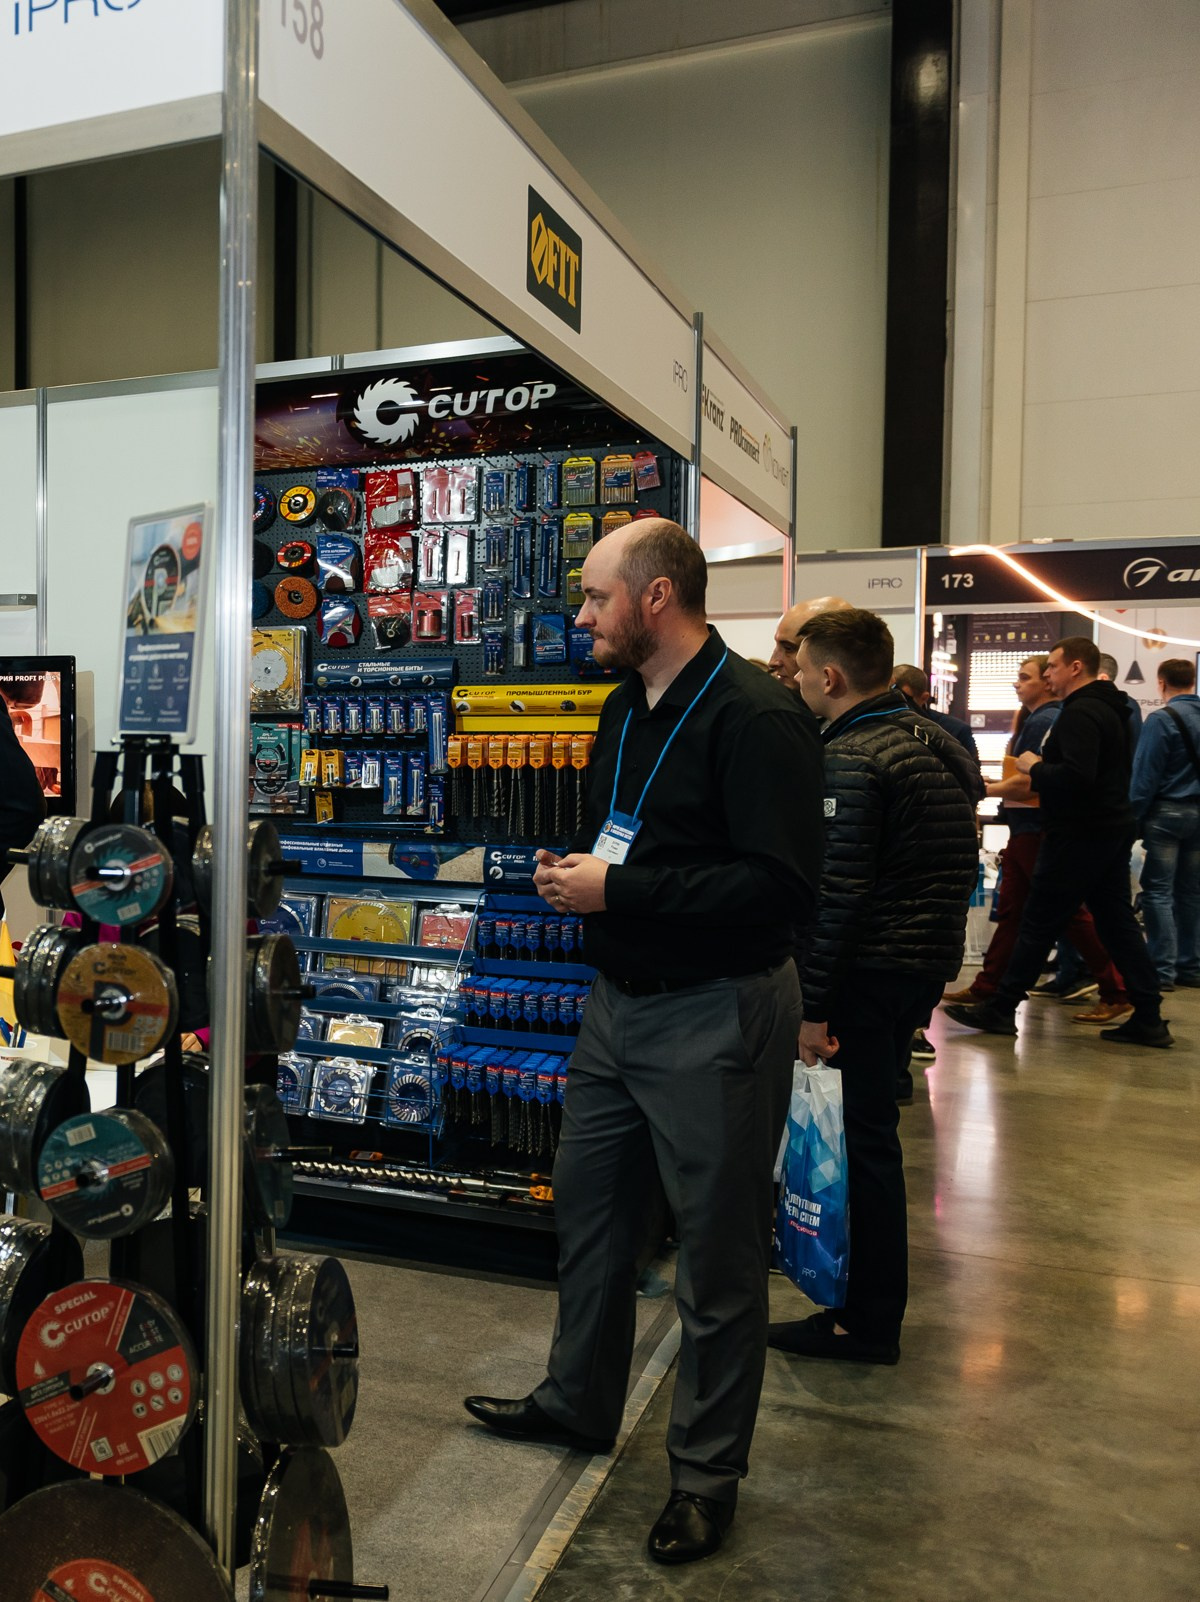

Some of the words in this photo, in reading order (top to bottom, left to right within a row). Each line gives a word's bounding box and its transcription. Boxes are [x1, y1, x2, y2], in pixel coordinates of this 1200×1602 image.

[546, 225, 579, 309] FIT
[427, 383, 557, 420] CUTOP
[867, 577, 903, 590] iPRO
[941, 573, 975, 589] 173
[506, 688, 576, 696] ПРОМЫШЛЕННЫЙ
[54, 1291, 98, 1315] SPECIAL
